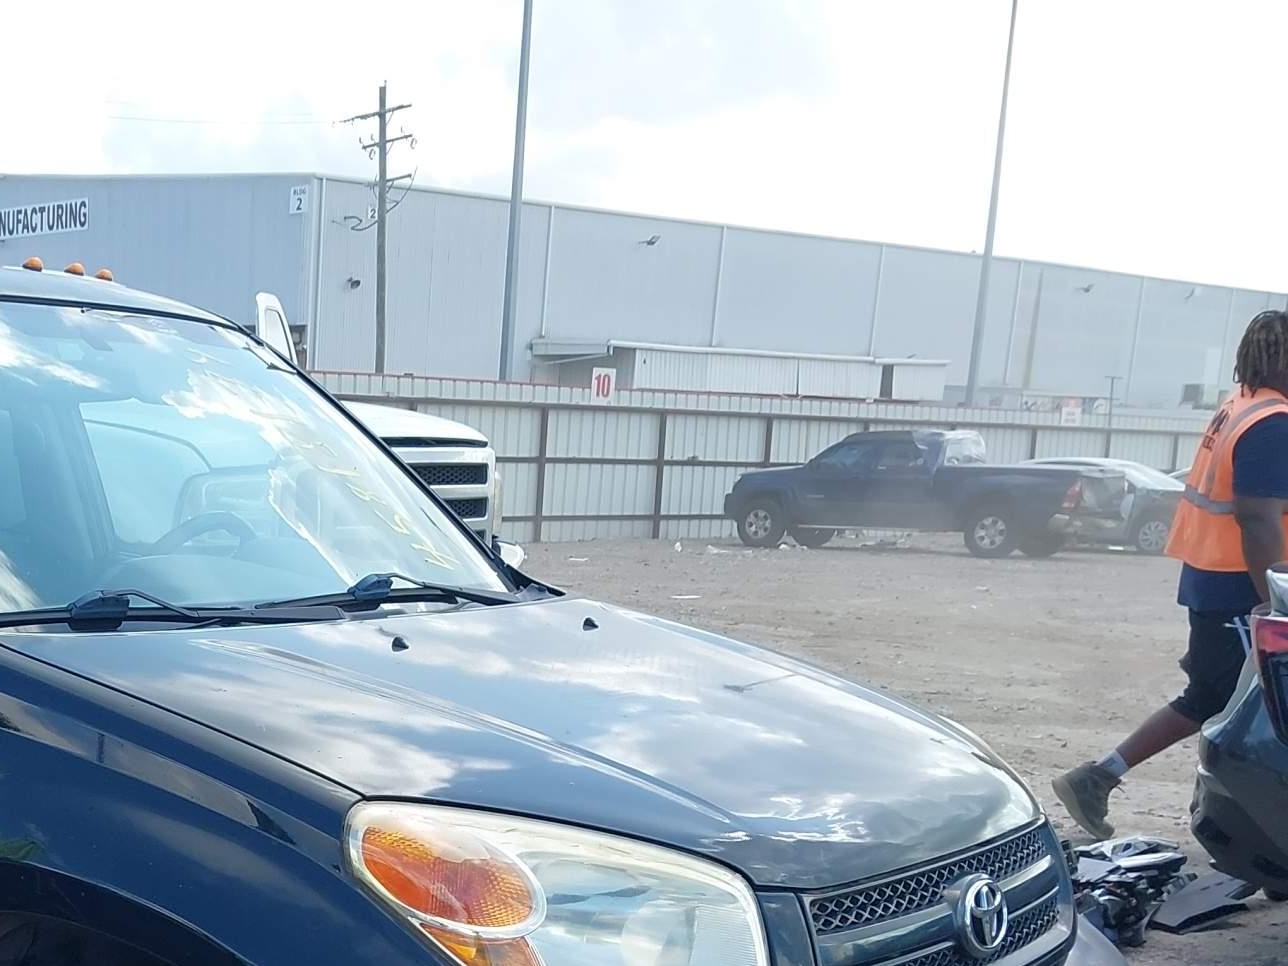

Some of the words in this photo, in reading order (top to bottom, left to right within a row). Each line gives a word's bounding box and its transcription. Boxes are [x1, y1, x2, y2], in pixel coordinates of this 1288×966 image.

[295, 197, 303, 211] 2
[369, 208, 377, 219] 2
[594, 373, 611, 398] 10
